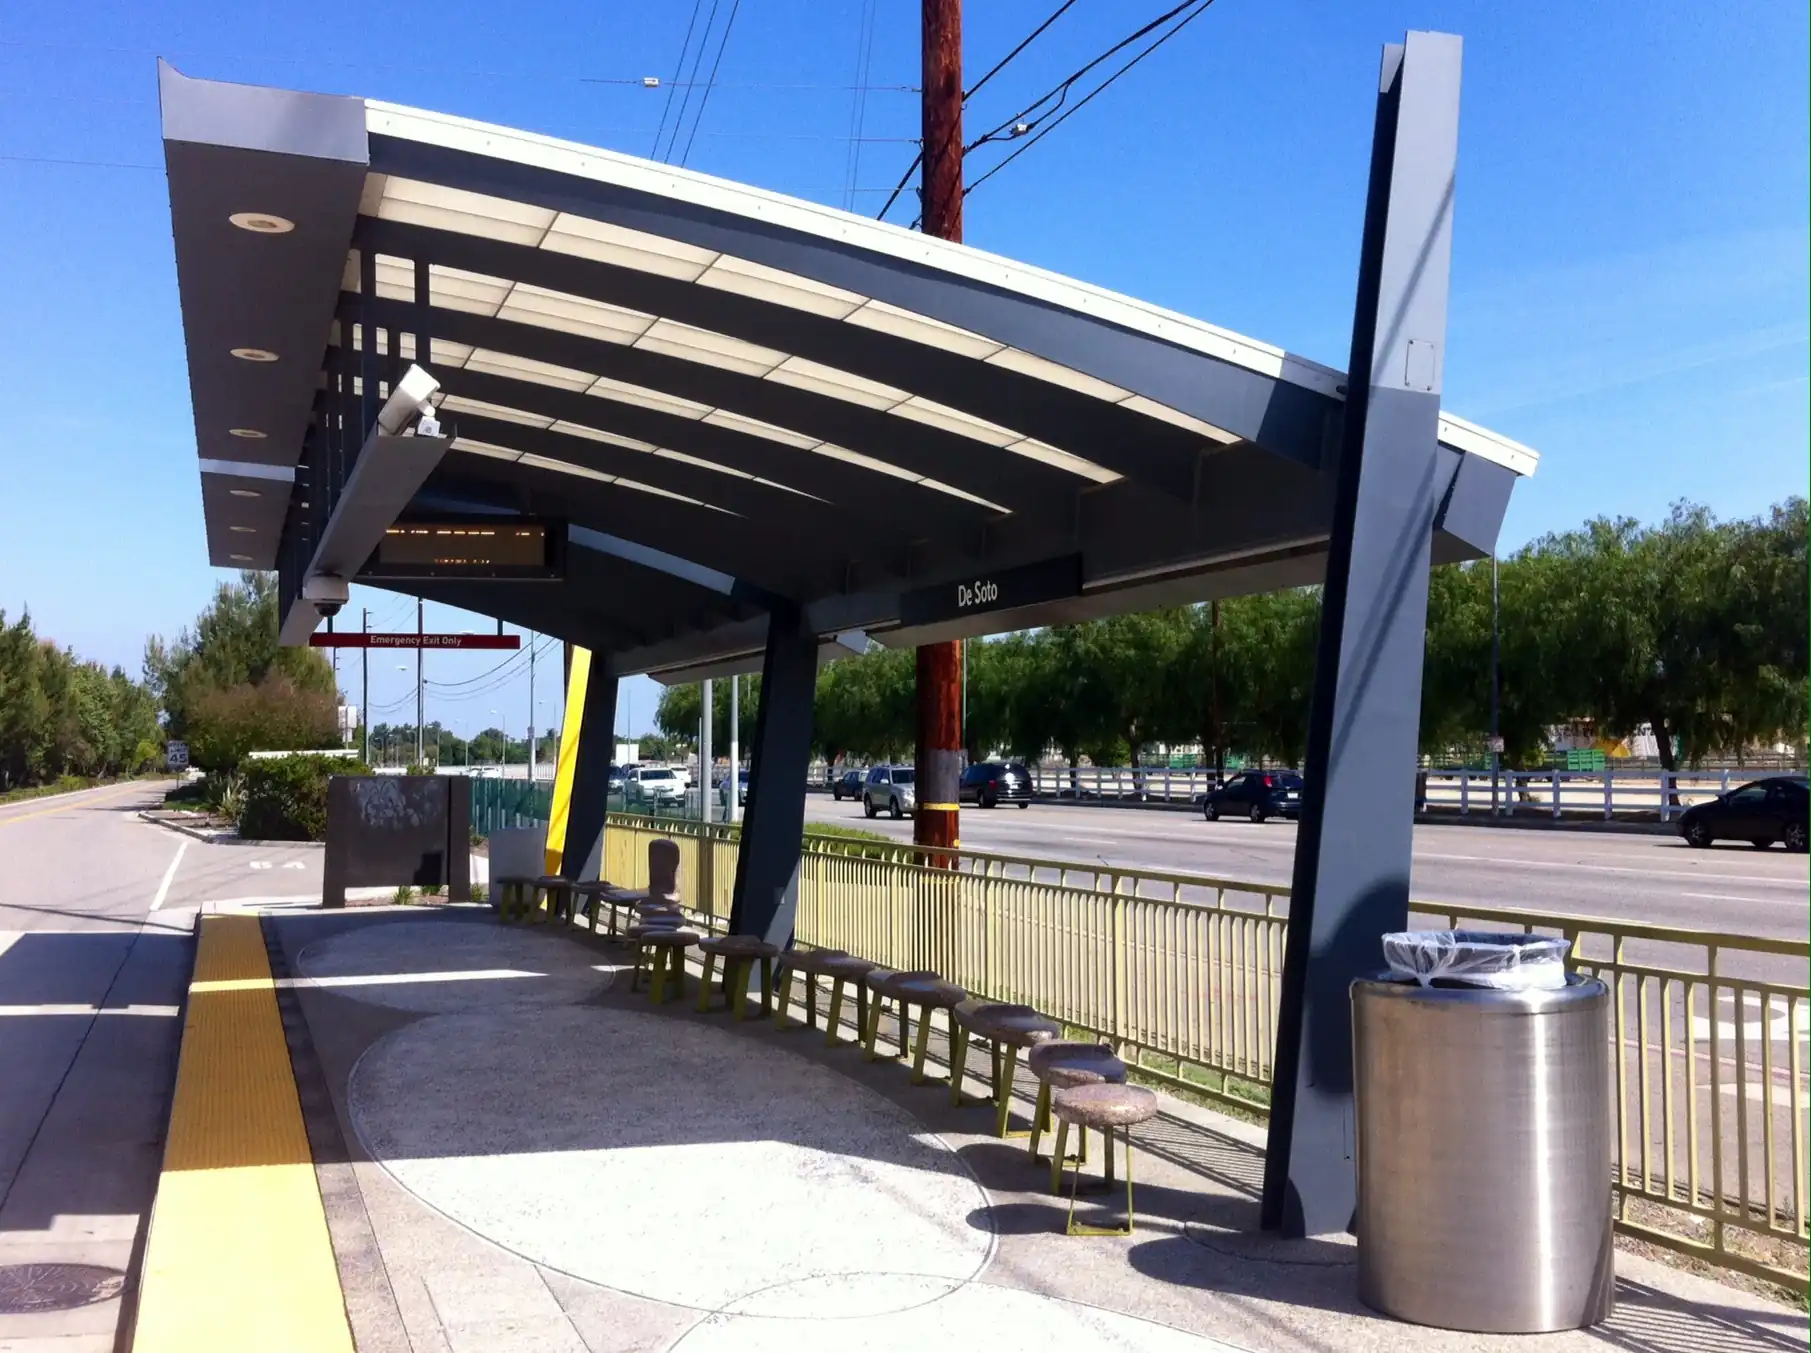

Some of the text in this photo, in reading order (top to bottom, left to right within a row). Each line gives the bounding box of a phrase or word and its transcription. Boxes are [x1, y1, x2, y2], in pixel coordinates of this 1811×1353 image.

[958, 580, 998, 607] De Soto
[370, 635, 462, 647] Emergency Exit Only
[169, 753, 188, 763] 45
